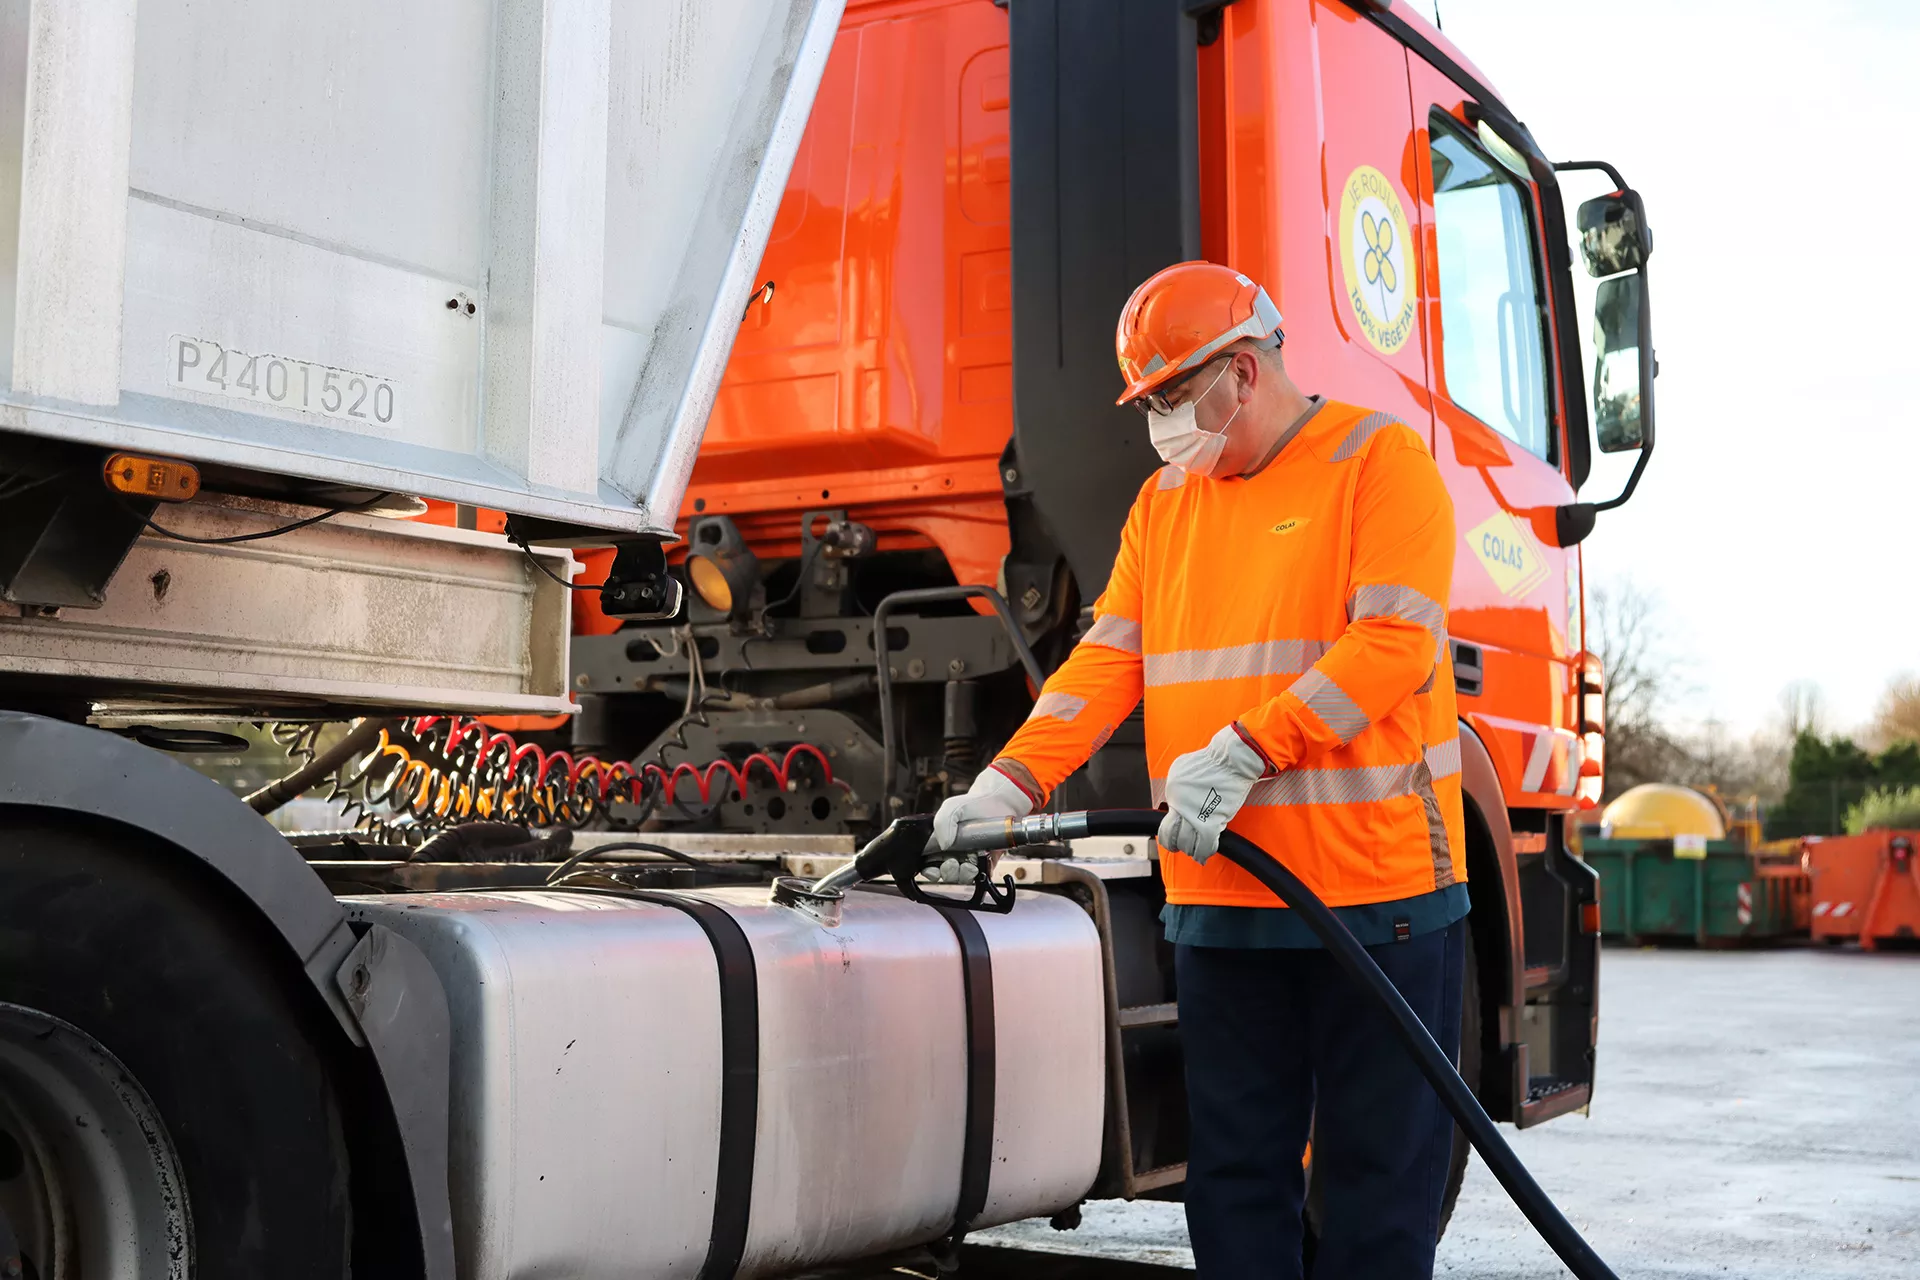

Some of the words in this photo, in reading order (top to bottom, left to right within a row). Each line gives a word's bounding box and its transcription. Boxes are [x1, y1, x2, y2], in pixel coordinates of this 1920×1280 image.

[1348, 180, 1362, 209] JE
[1361, 173, 1400, 225] ROULE
[1351, 286, 1376, 339] 100%
[177, 340, 394, 423] P4401520
[1275, 520, 1296, 532] COLAS
[1482, 531, 1524, 571] COLAS
